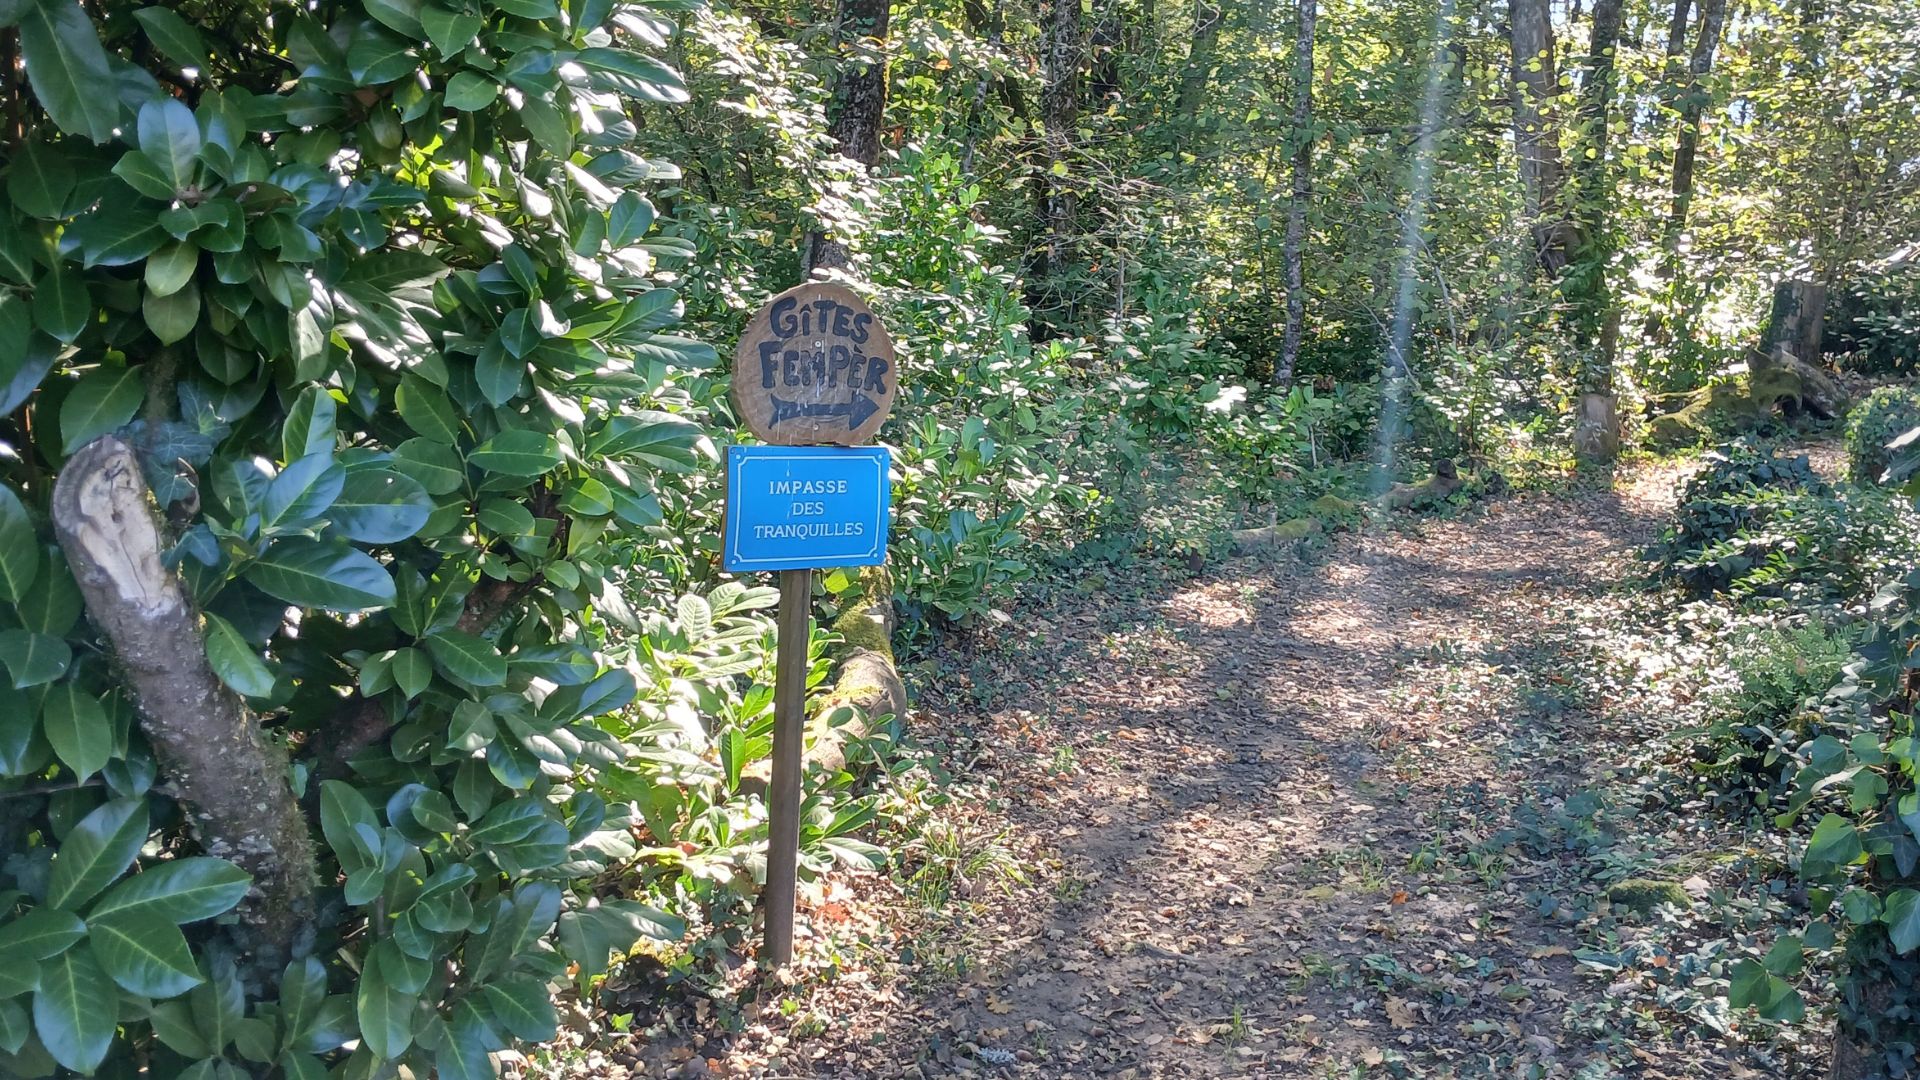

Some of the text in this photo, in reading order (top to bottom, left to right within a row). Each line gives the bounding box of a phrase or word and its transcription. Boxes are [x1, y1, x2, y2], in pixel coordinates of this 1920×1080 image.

[769, 480, 848, 494] IMPASSE
[792, 502, 824, 516] DES
[754, 522, 863, 539] TRANQUILLES
